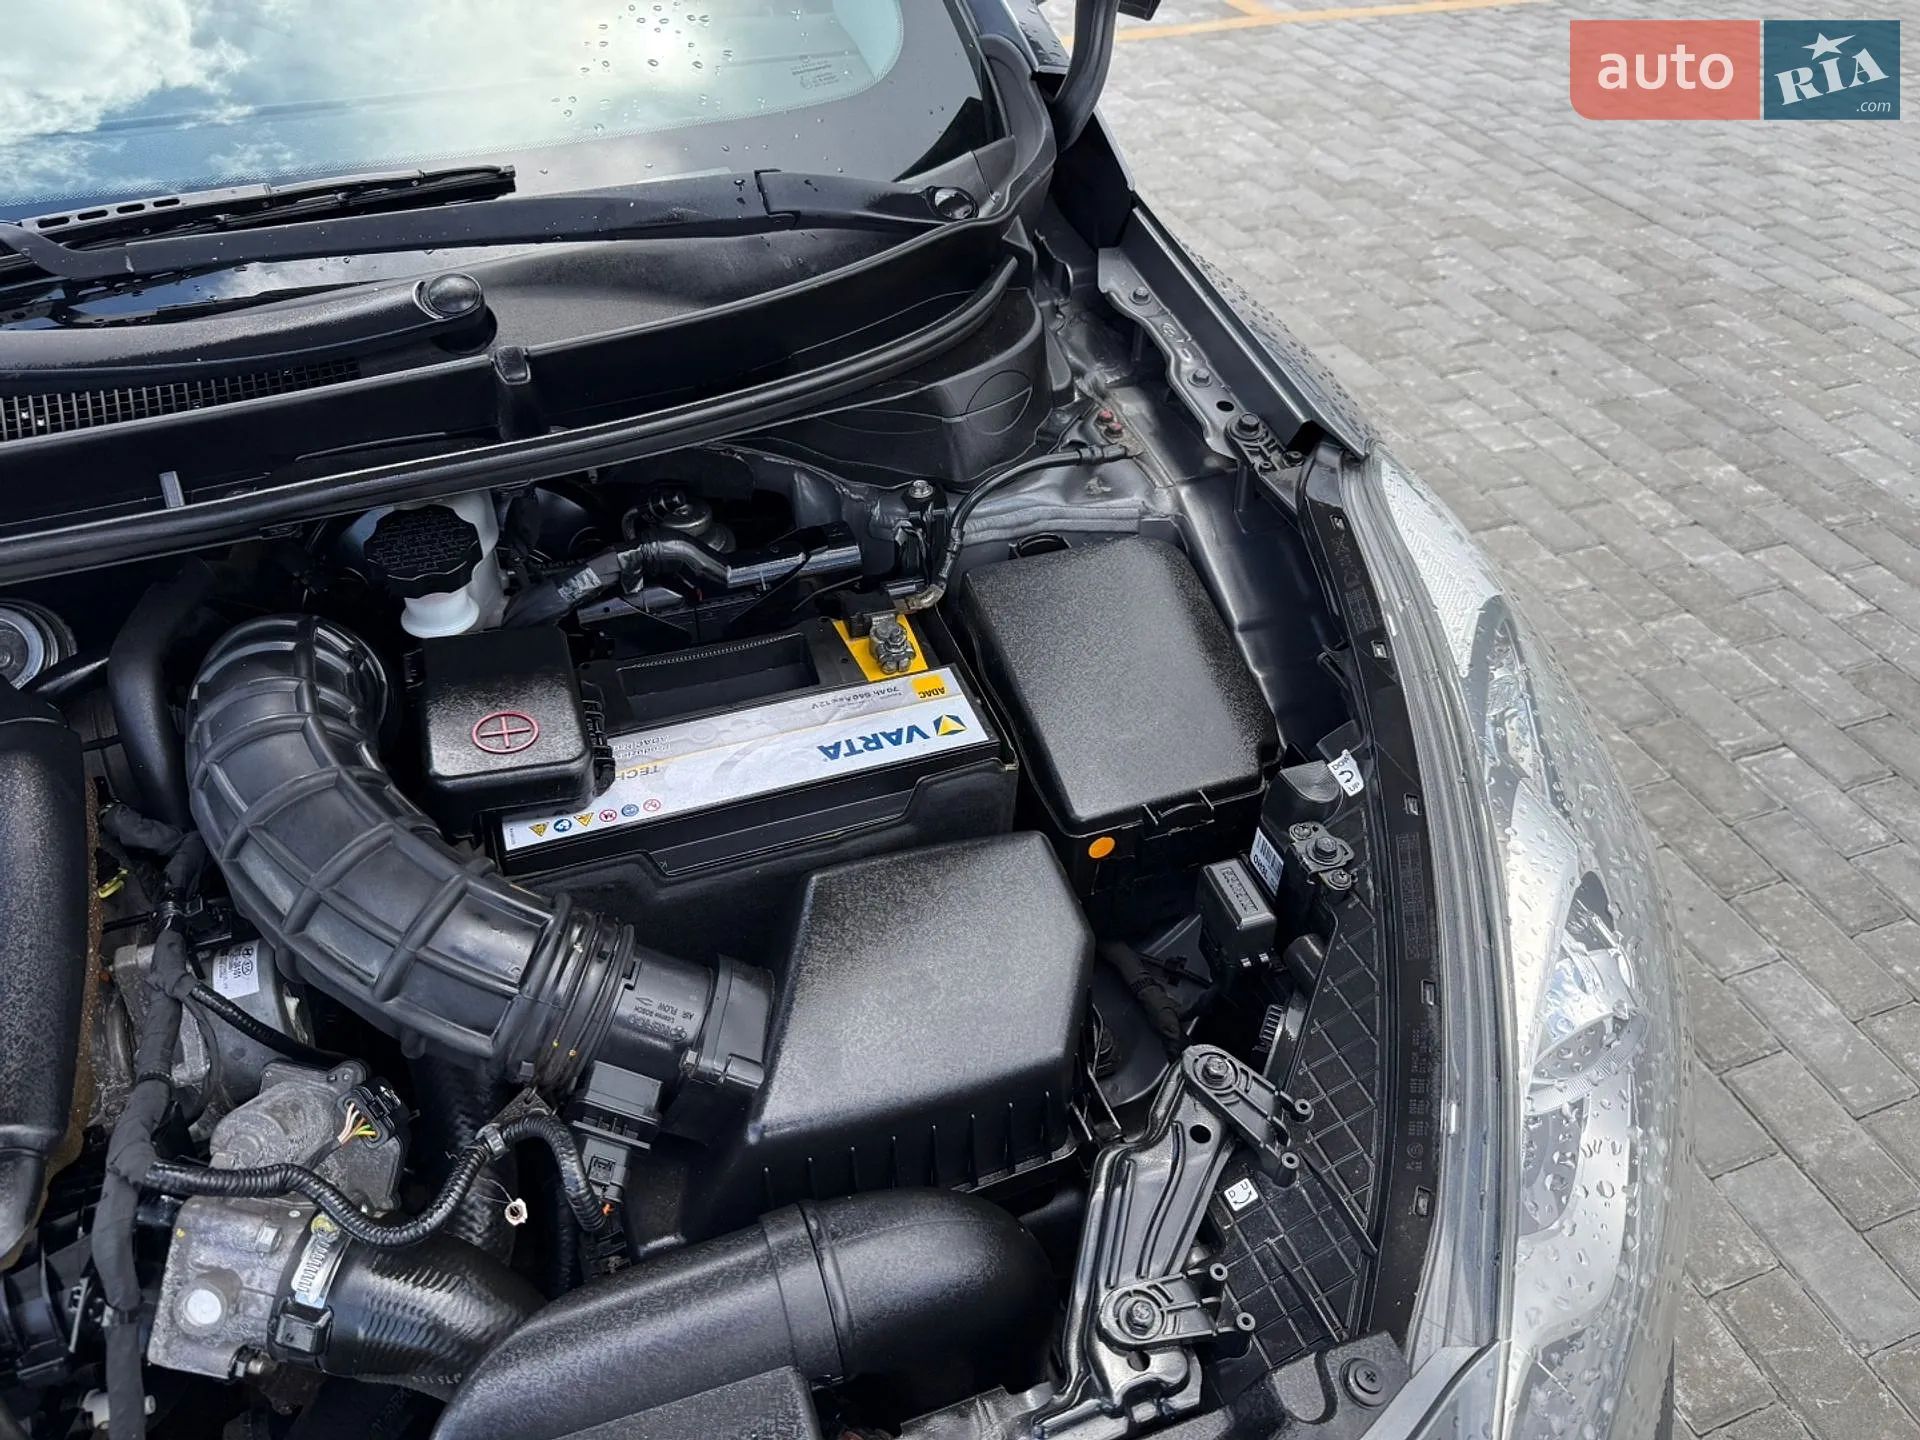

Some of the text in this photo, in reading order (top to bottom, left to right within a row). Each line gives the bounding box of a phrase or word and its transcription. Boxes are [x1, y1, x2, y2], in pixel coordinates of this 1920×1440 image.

[918, 686, 946, 699] ADAC
[817, 724, 930, 761] VARTA
[658, 1002, 678, 1015] FLOW
